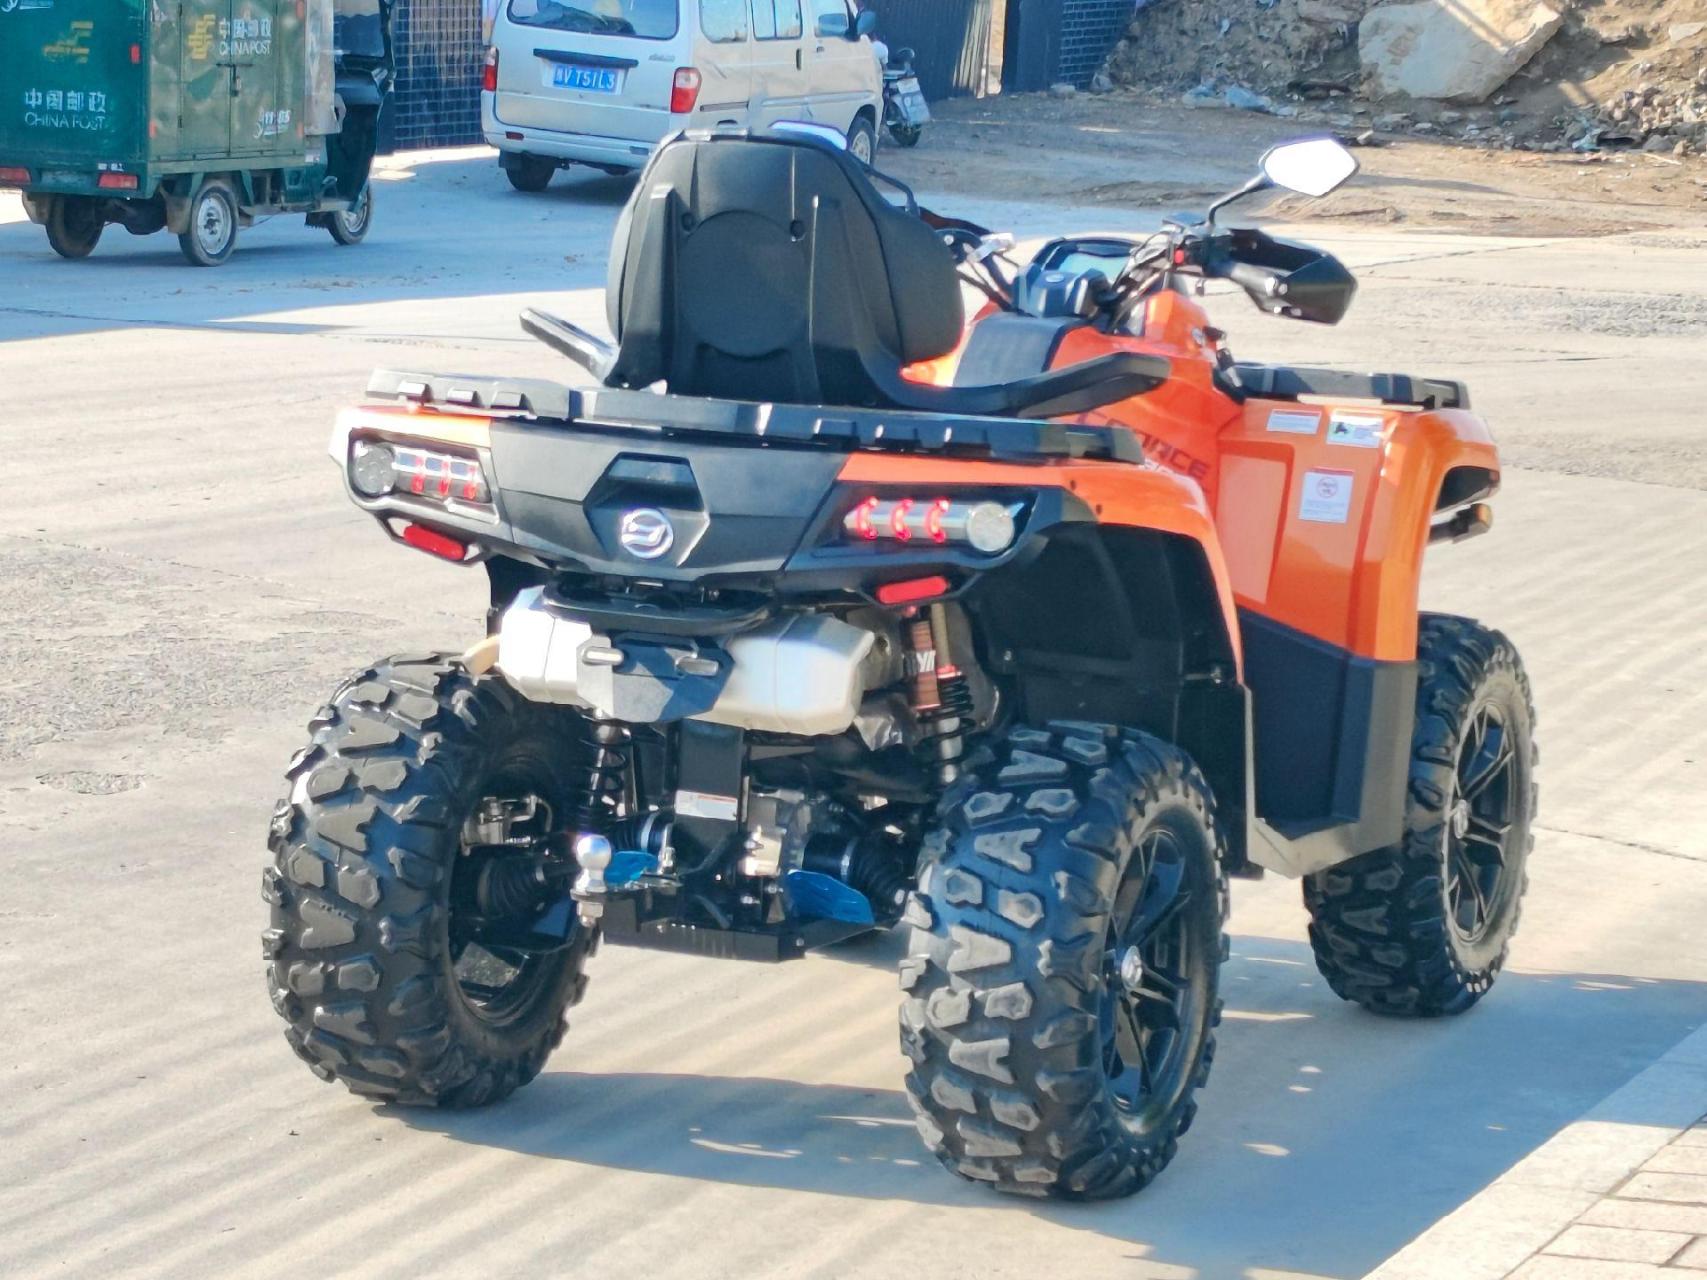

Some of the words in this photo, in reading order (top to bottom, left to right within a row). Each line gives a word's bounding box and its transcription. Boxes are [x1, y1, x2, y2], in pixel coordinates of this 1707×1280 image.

[25, 88, 106, 112] 中国邮政
[24, 111, 70, 129] CHINA
